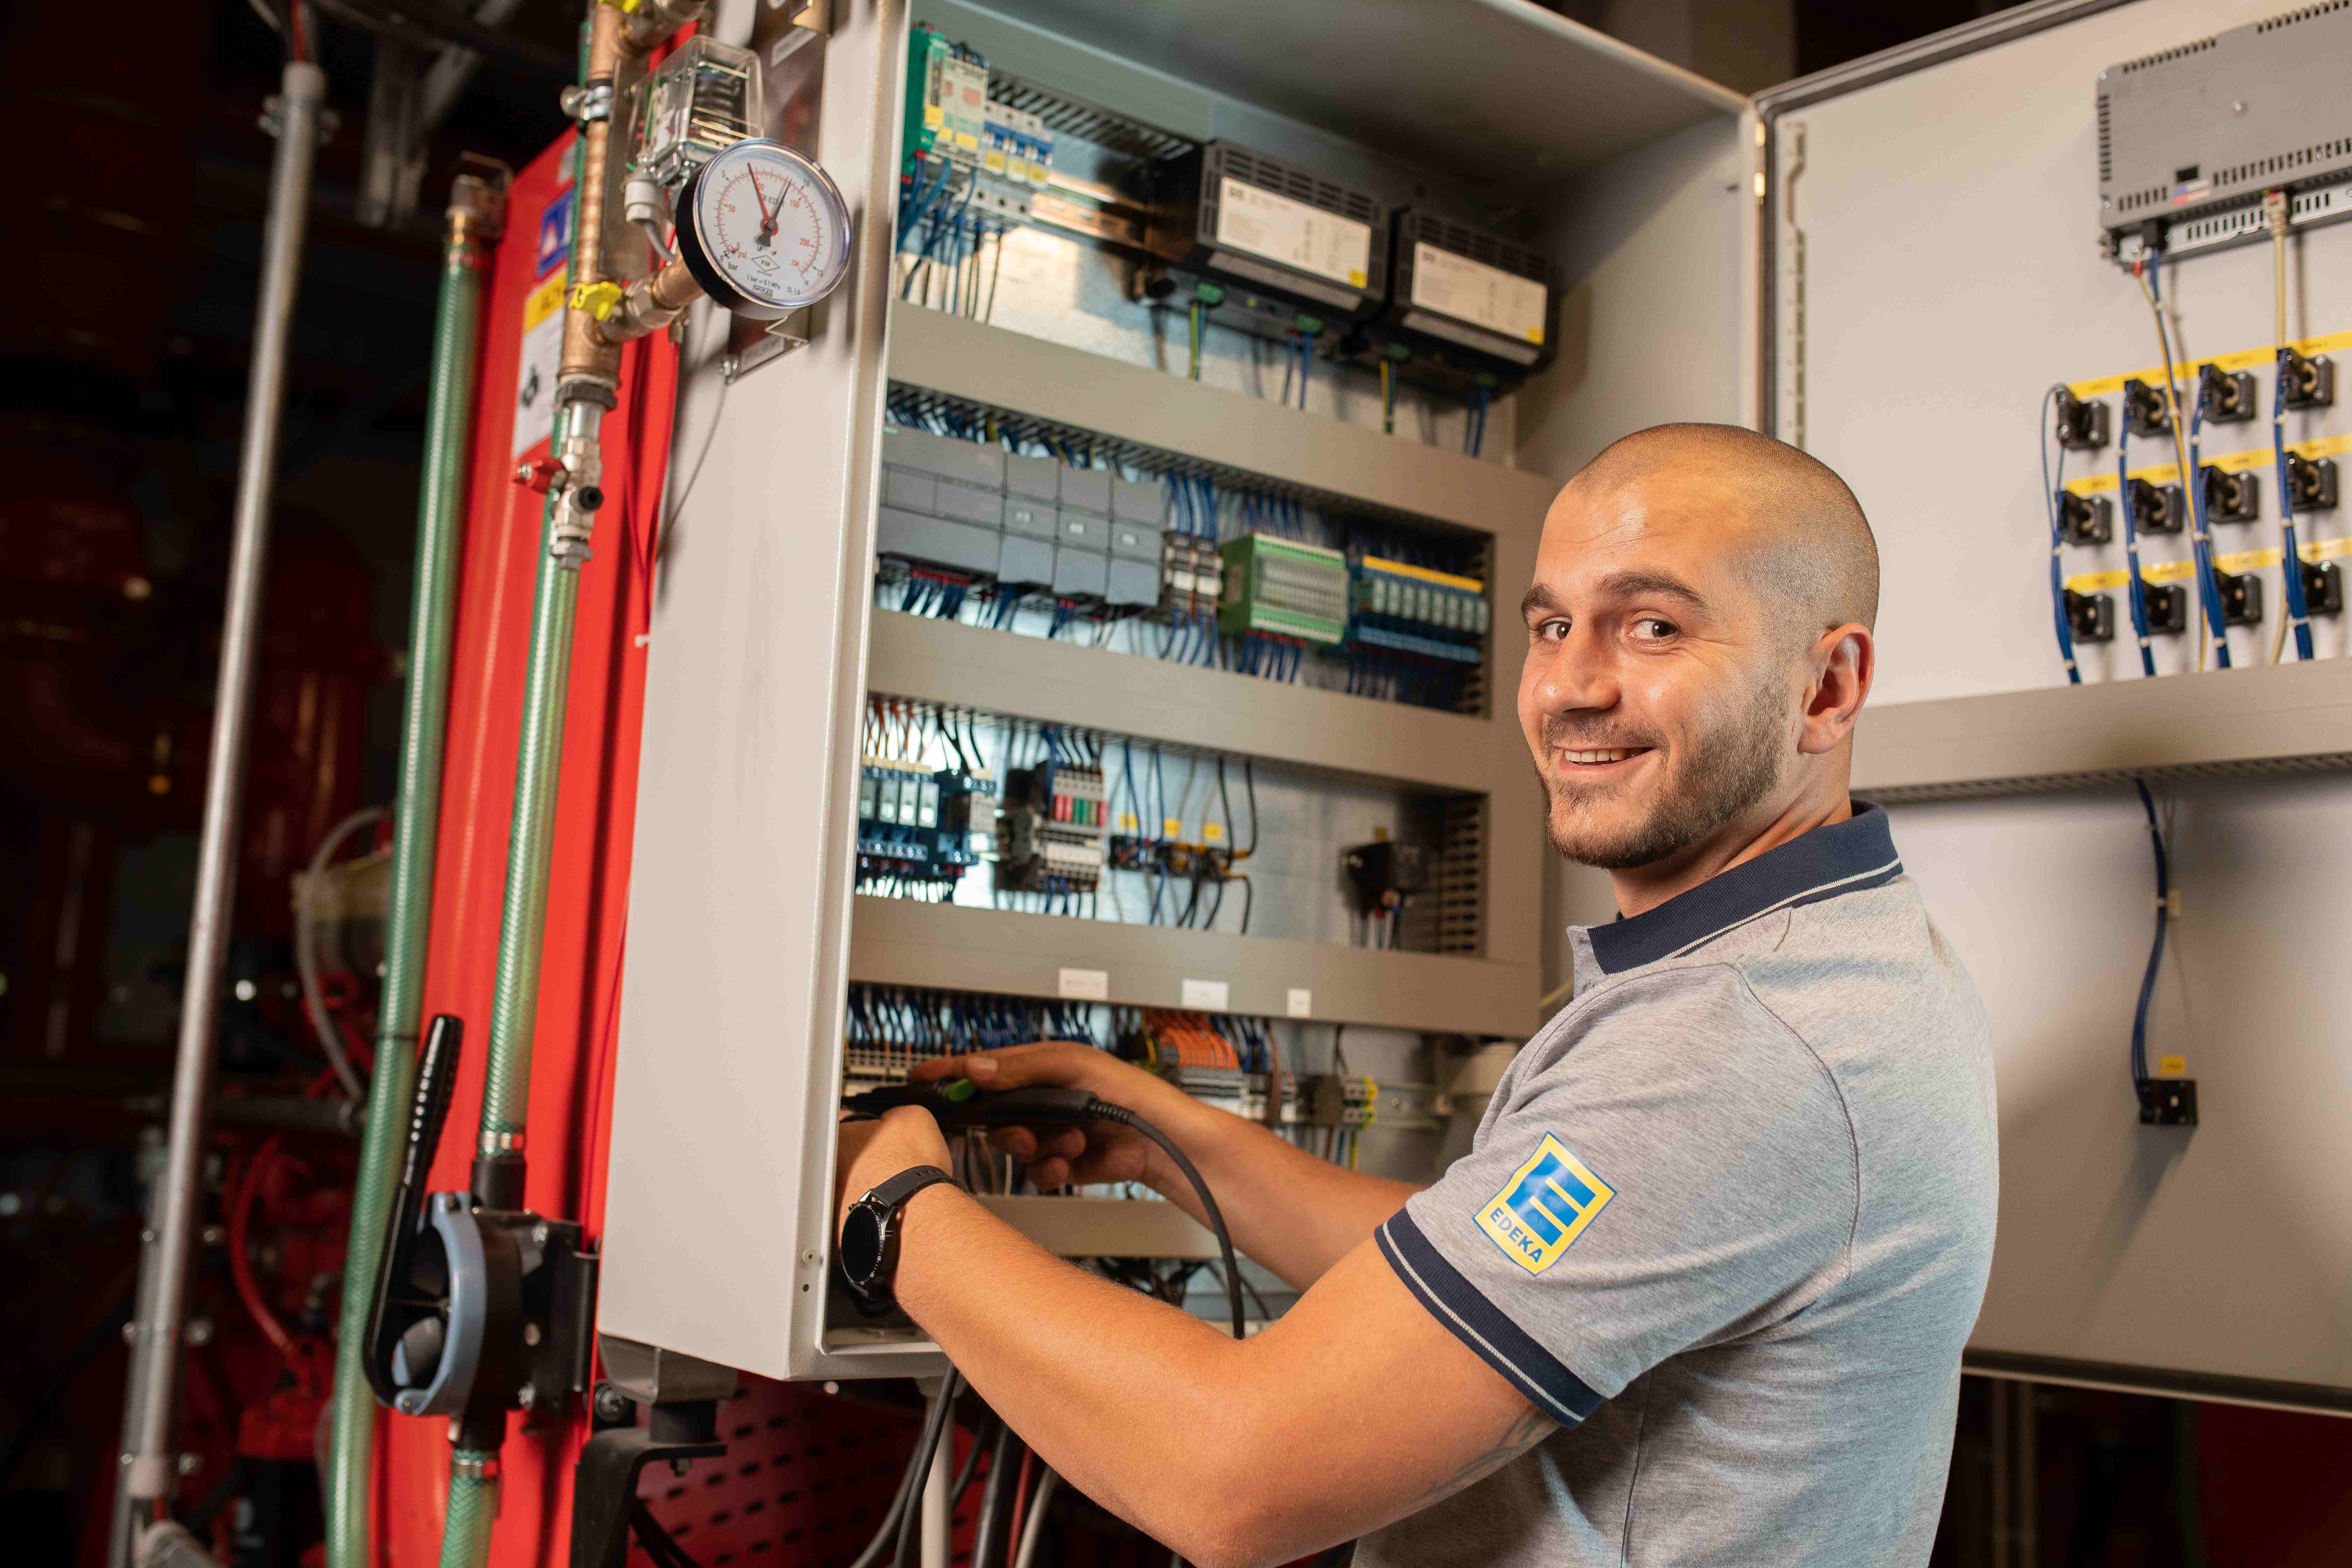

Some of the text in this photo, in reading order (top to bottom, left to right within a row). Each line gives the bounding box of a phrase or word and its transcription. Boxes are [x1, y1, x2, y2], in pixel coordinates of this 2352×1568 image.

[790, 199, 800, 208] 150
[800, 238, 810, 246] 200
[728, 262, 738, 271] bar
[817, 269, 824, 278] 15
[1489, 1206, 1543, 1263] EDEKA
